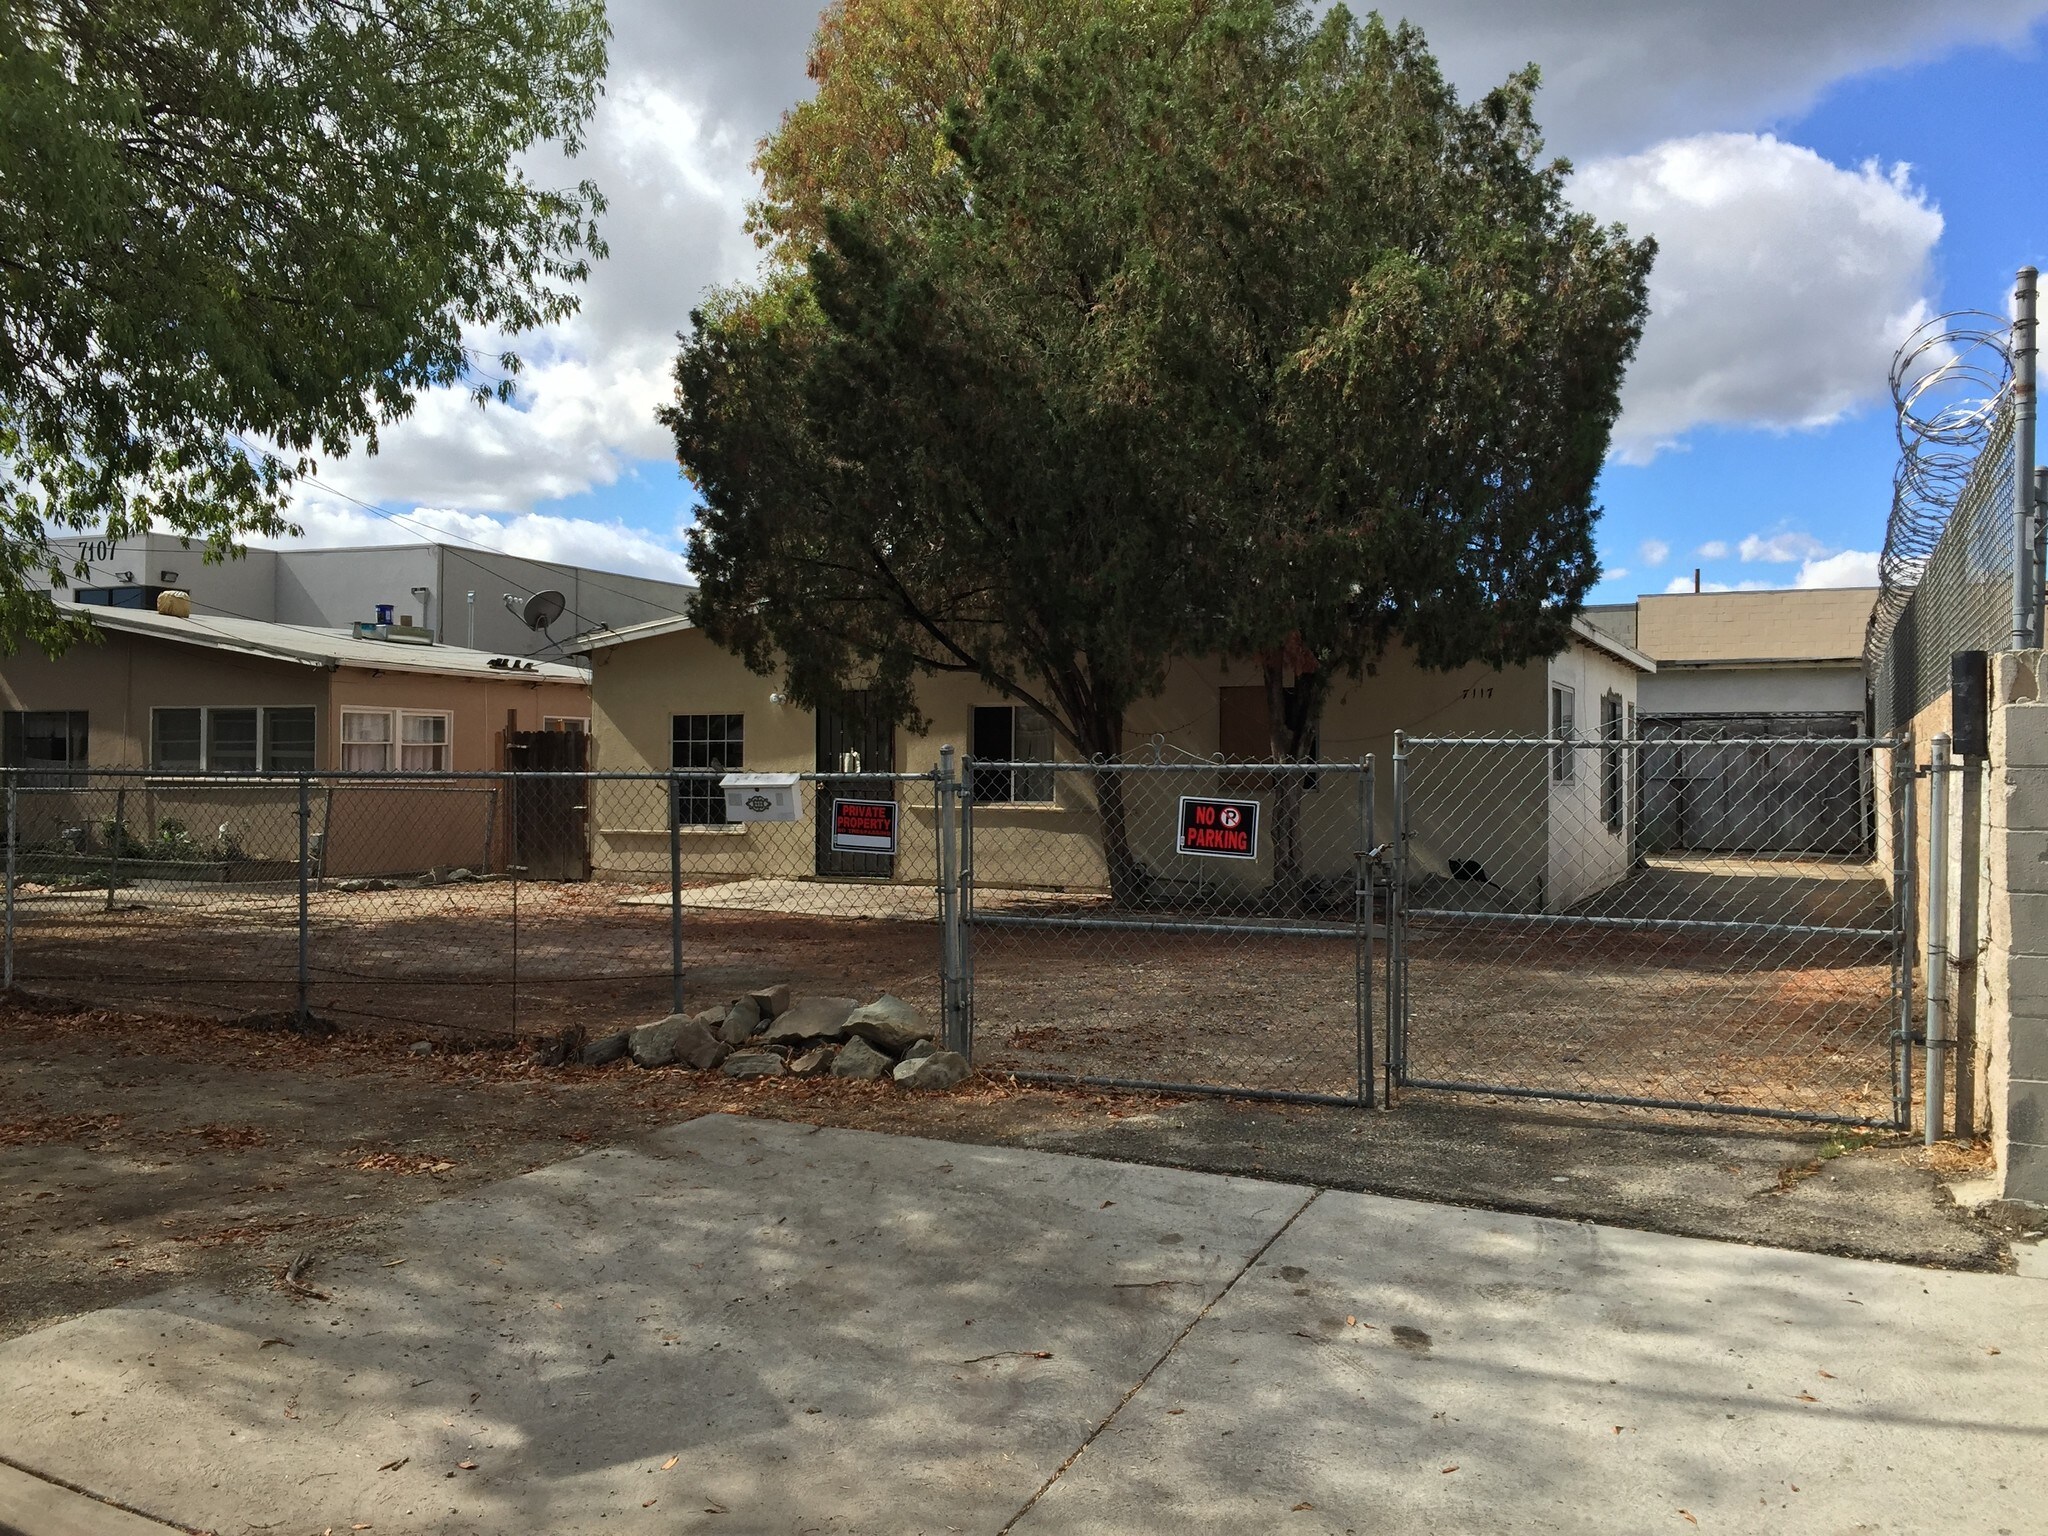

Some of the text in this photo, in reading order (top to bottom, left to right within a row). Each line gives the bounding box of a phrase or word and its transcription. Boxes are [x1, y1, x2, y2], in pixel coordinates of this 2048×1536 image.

[78, 540, 117, 562] 7107
[1463, 687, 1494, 700] 7117
[842, 805, 886, 818] PRIVATE
[1196, 806, 1215, 826] NO
[837, 816, 891, 830] PROPERTY
[1187, 827, 1248, 850] PARKING
